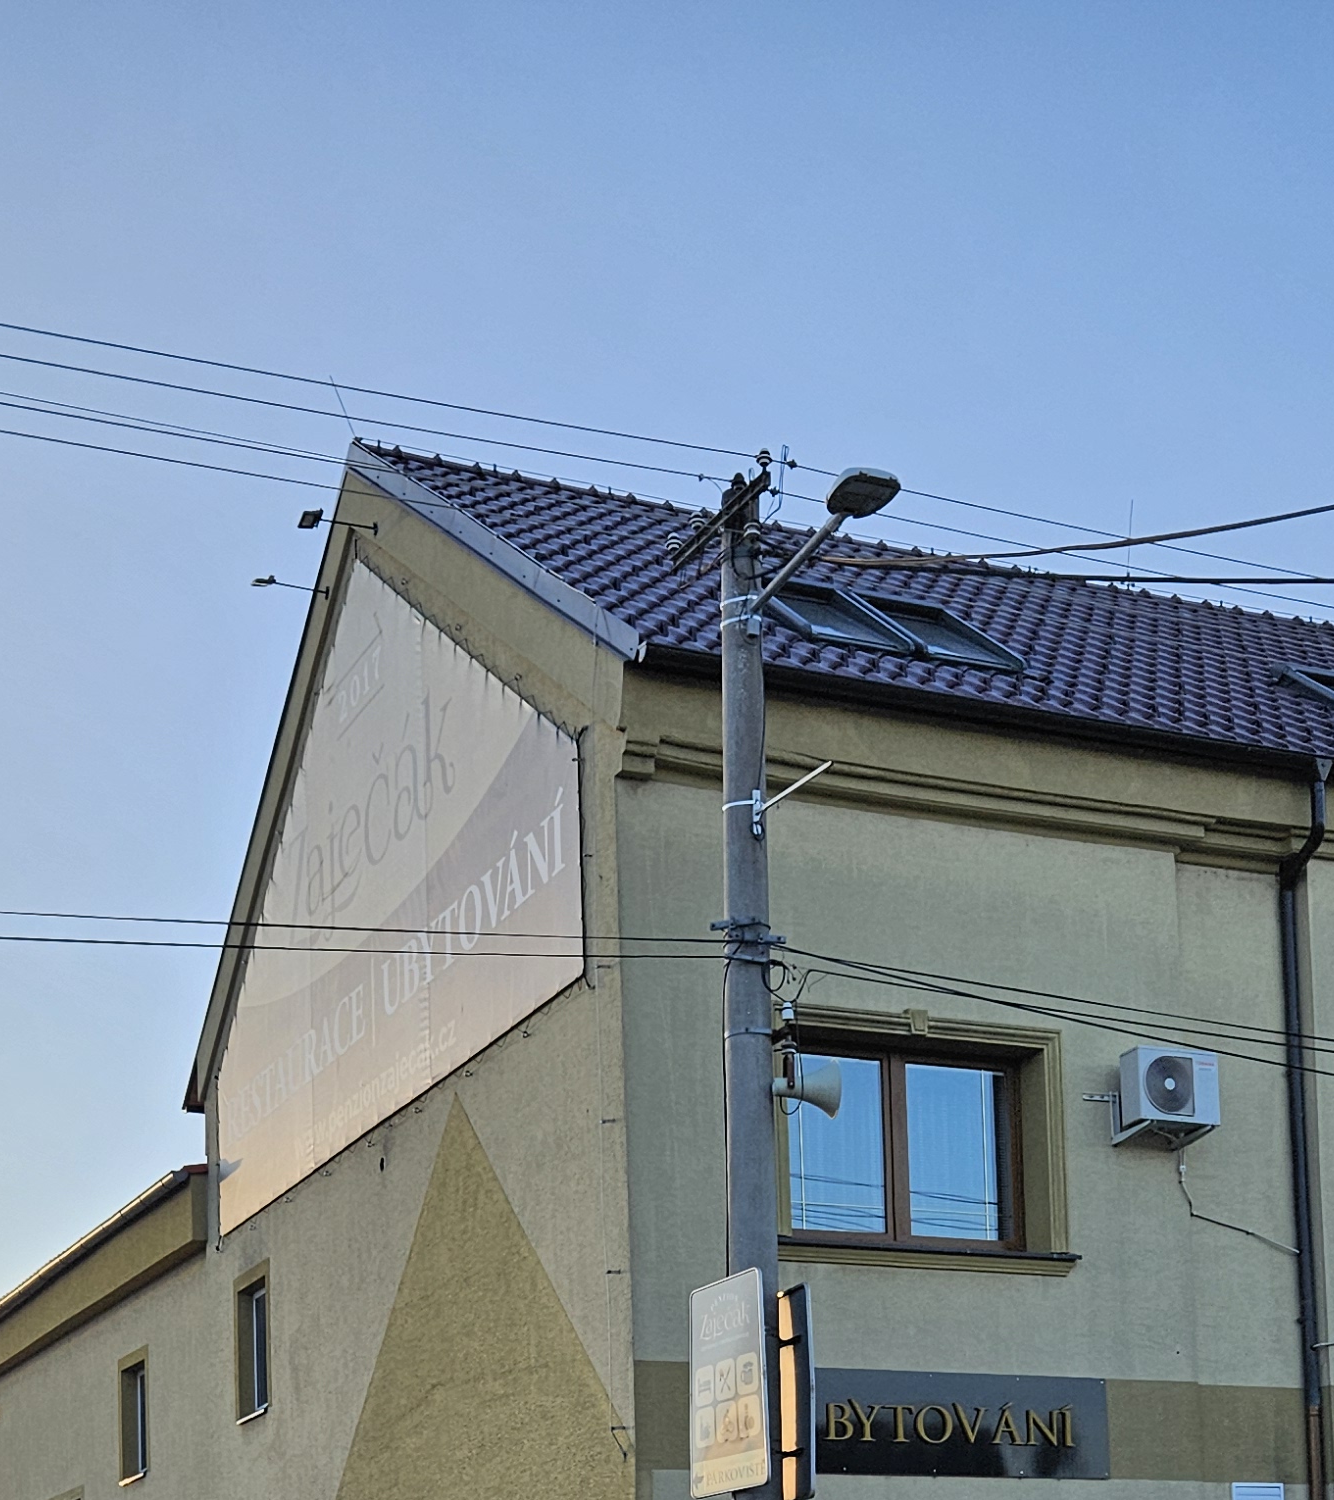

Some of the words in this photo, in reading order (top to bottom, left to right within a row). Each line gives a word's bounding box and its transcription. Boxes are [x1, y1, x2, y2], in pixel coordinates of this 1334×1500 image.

[337, 645, 383, 725] 2017
[287, 686, 456, 948] Zaječák
[226, 983, 366, 1147] RESTAURACE
[381, 786, 566, 1016] UBYTOVÁNÍ
[824, 1398, 1077, 1448] BYTOVÁNÍ
